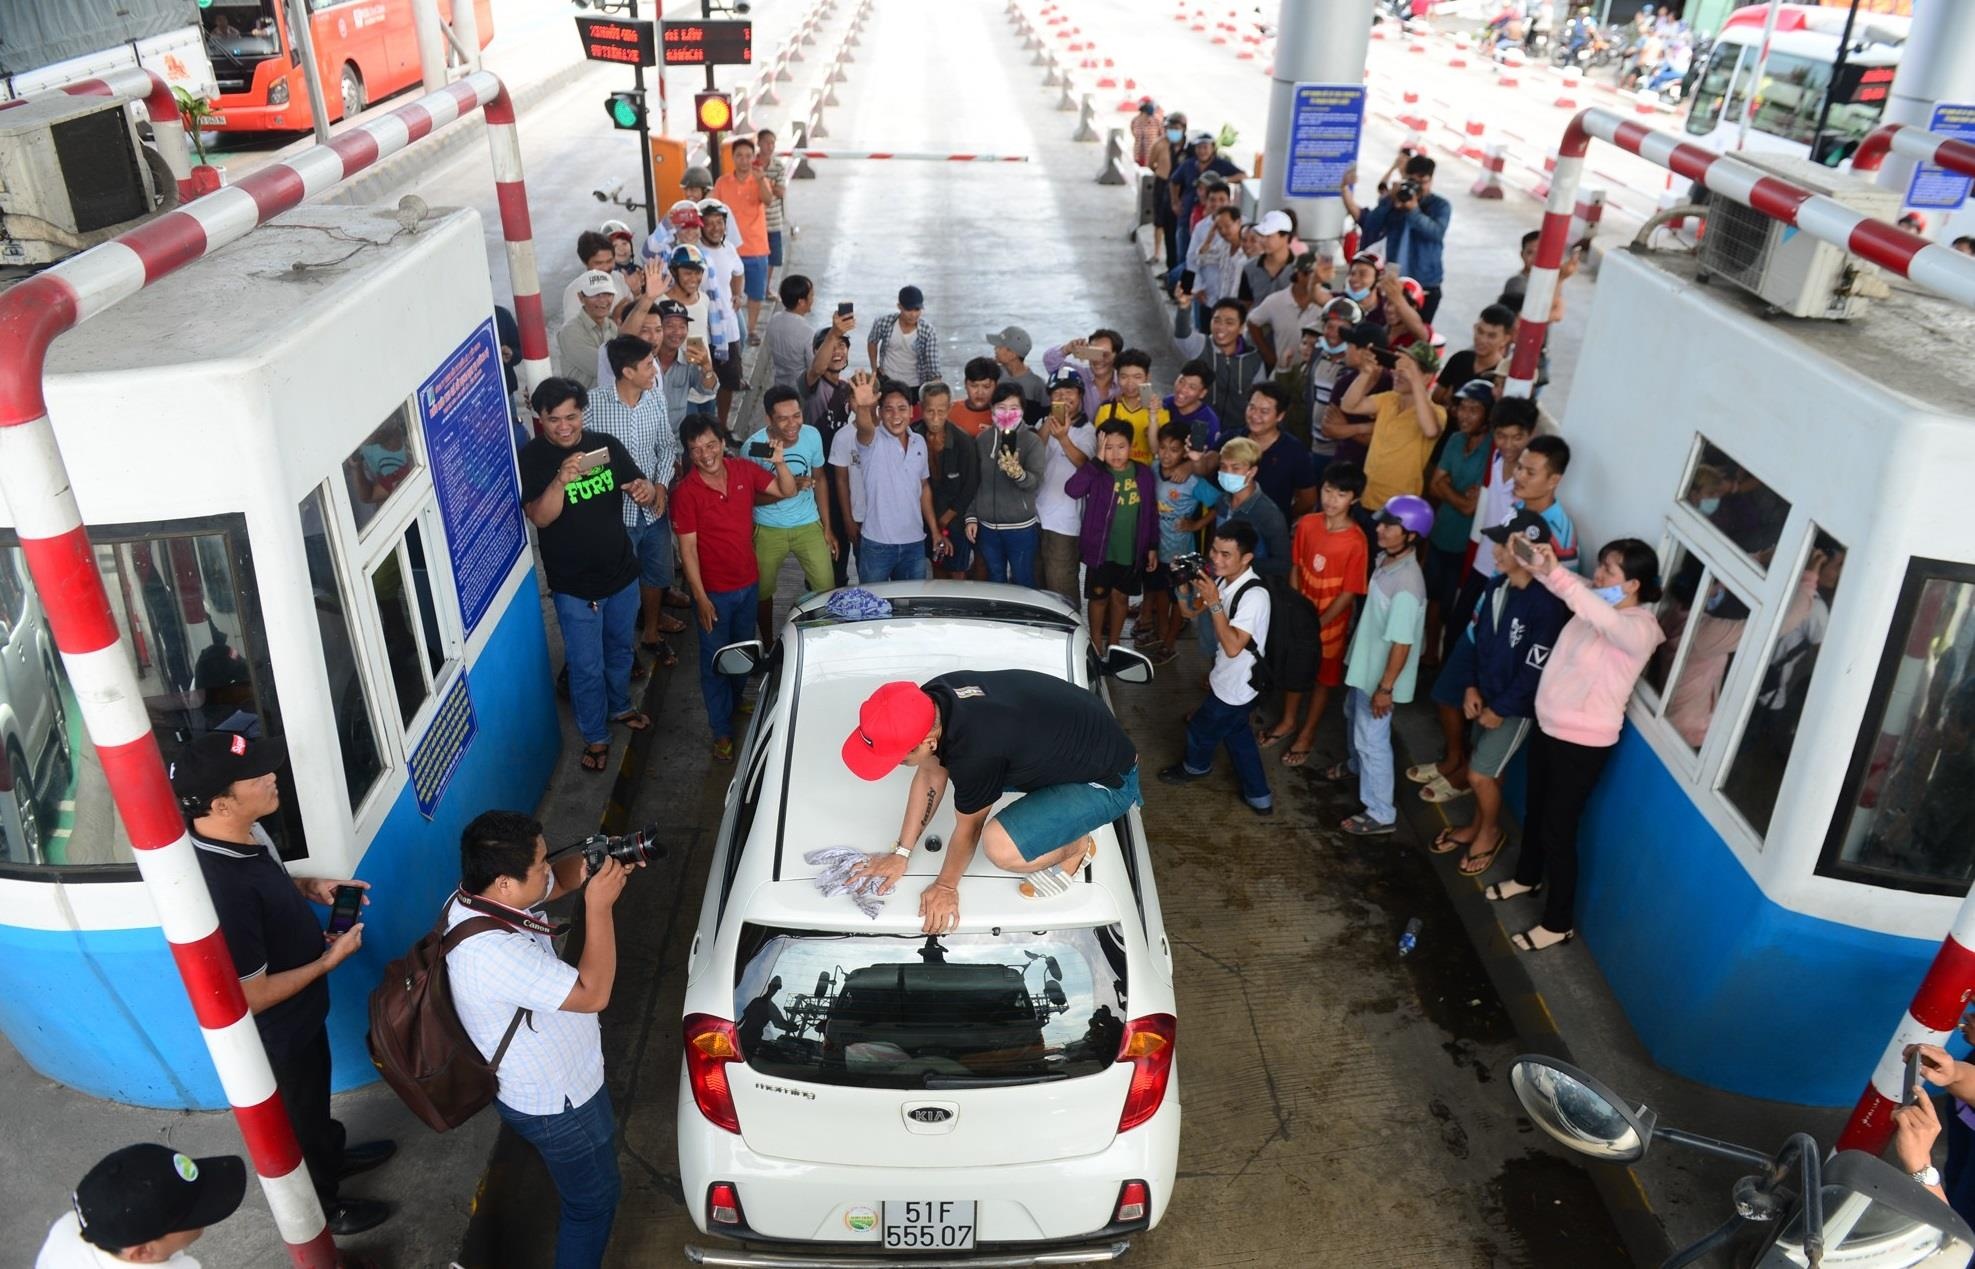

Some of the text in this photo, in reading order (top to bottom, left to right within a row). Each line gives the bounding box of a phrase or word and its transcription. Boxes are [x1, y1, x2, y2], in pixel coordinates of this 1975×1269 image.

[564, 468, 614, 504] FURY
[523, 919, 550, 933] Canon
[755, 1082, 816, 1100] morning
[914, 1110, 947, 1121] KIA
[906, 1202, 954, 1223] 51F
[887, 1225, 972, 1247] 555.07
